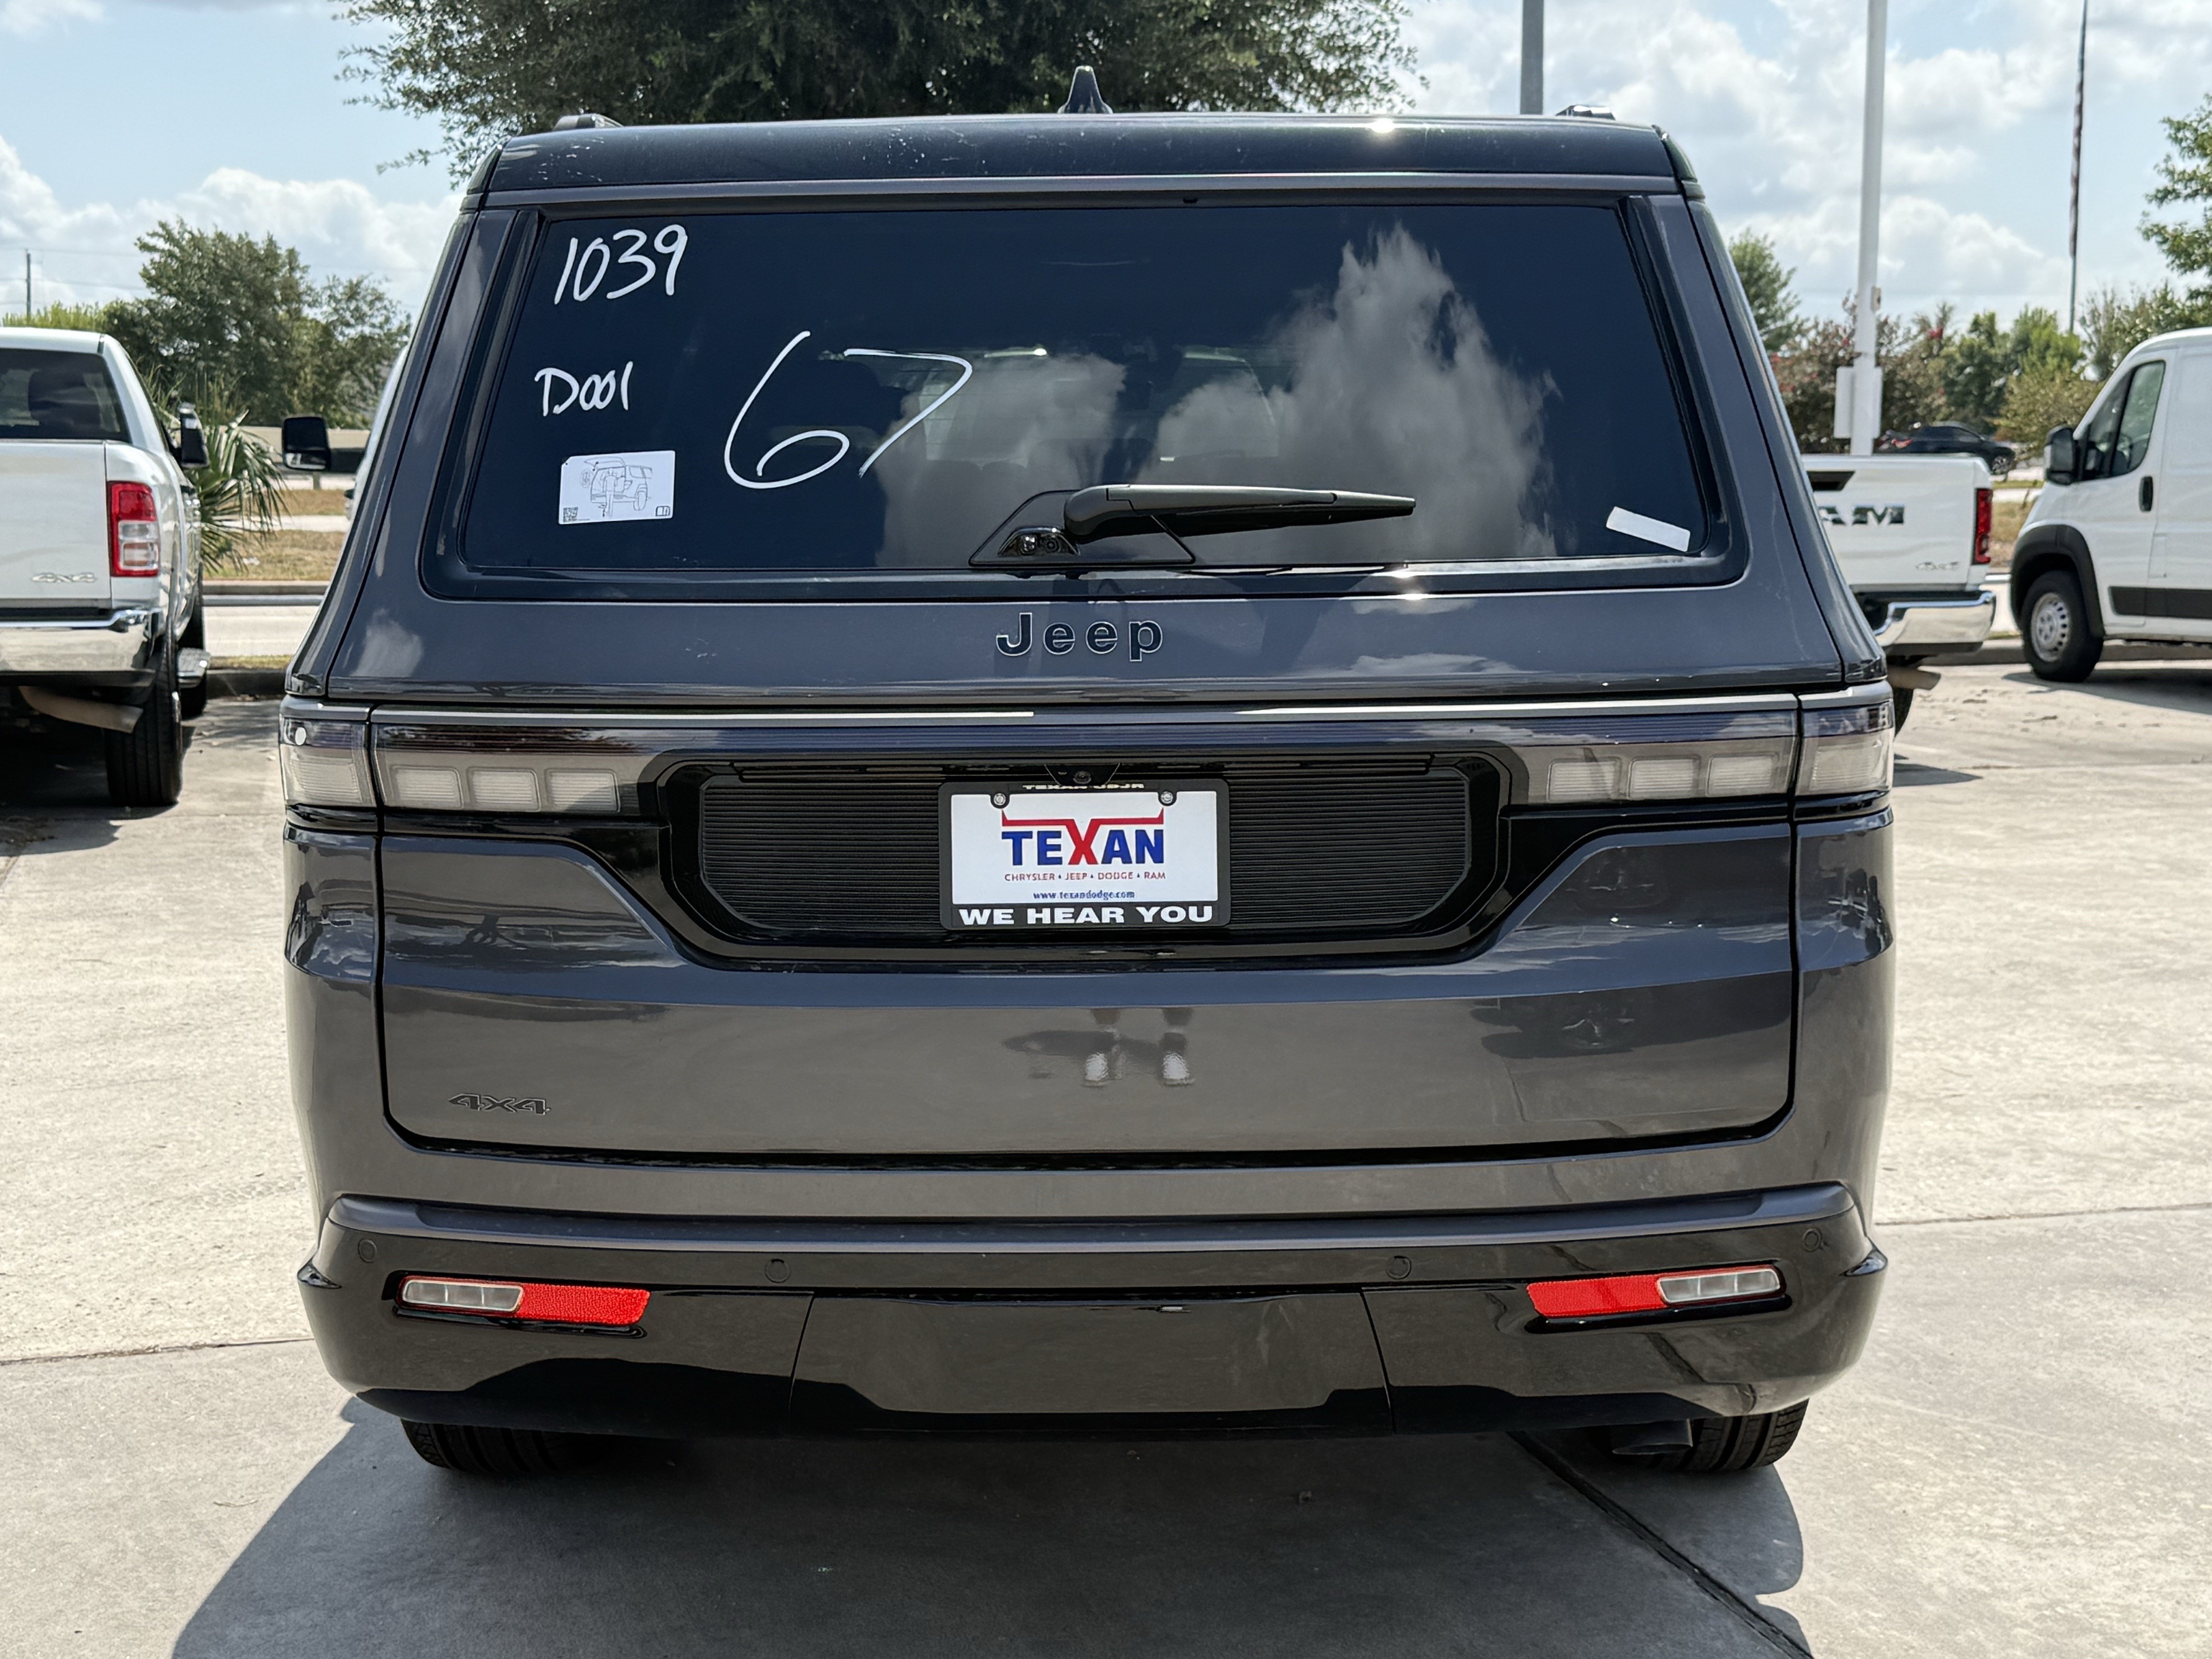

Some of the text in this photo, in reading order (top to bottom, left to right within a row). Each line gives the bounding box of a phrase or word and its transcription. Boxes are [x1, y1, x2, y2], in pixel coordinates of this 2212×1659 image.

[554, 224, 688, 305] 1039
[724, 330, 973, 489] 67
[996, 612, 1163, 662] Jeep
[1001, 807, 1164, 866] TEXAN
[1005, 873, 1055, 881] CHRYSLER
[1065, 872, 1088, 880] JEEP
[1098, 871, 1133, 880] DODGE
[1033, 890, 1135, 900] www.texandodge.com
[958, 906, 1212, 925] WE HEAR YOU
